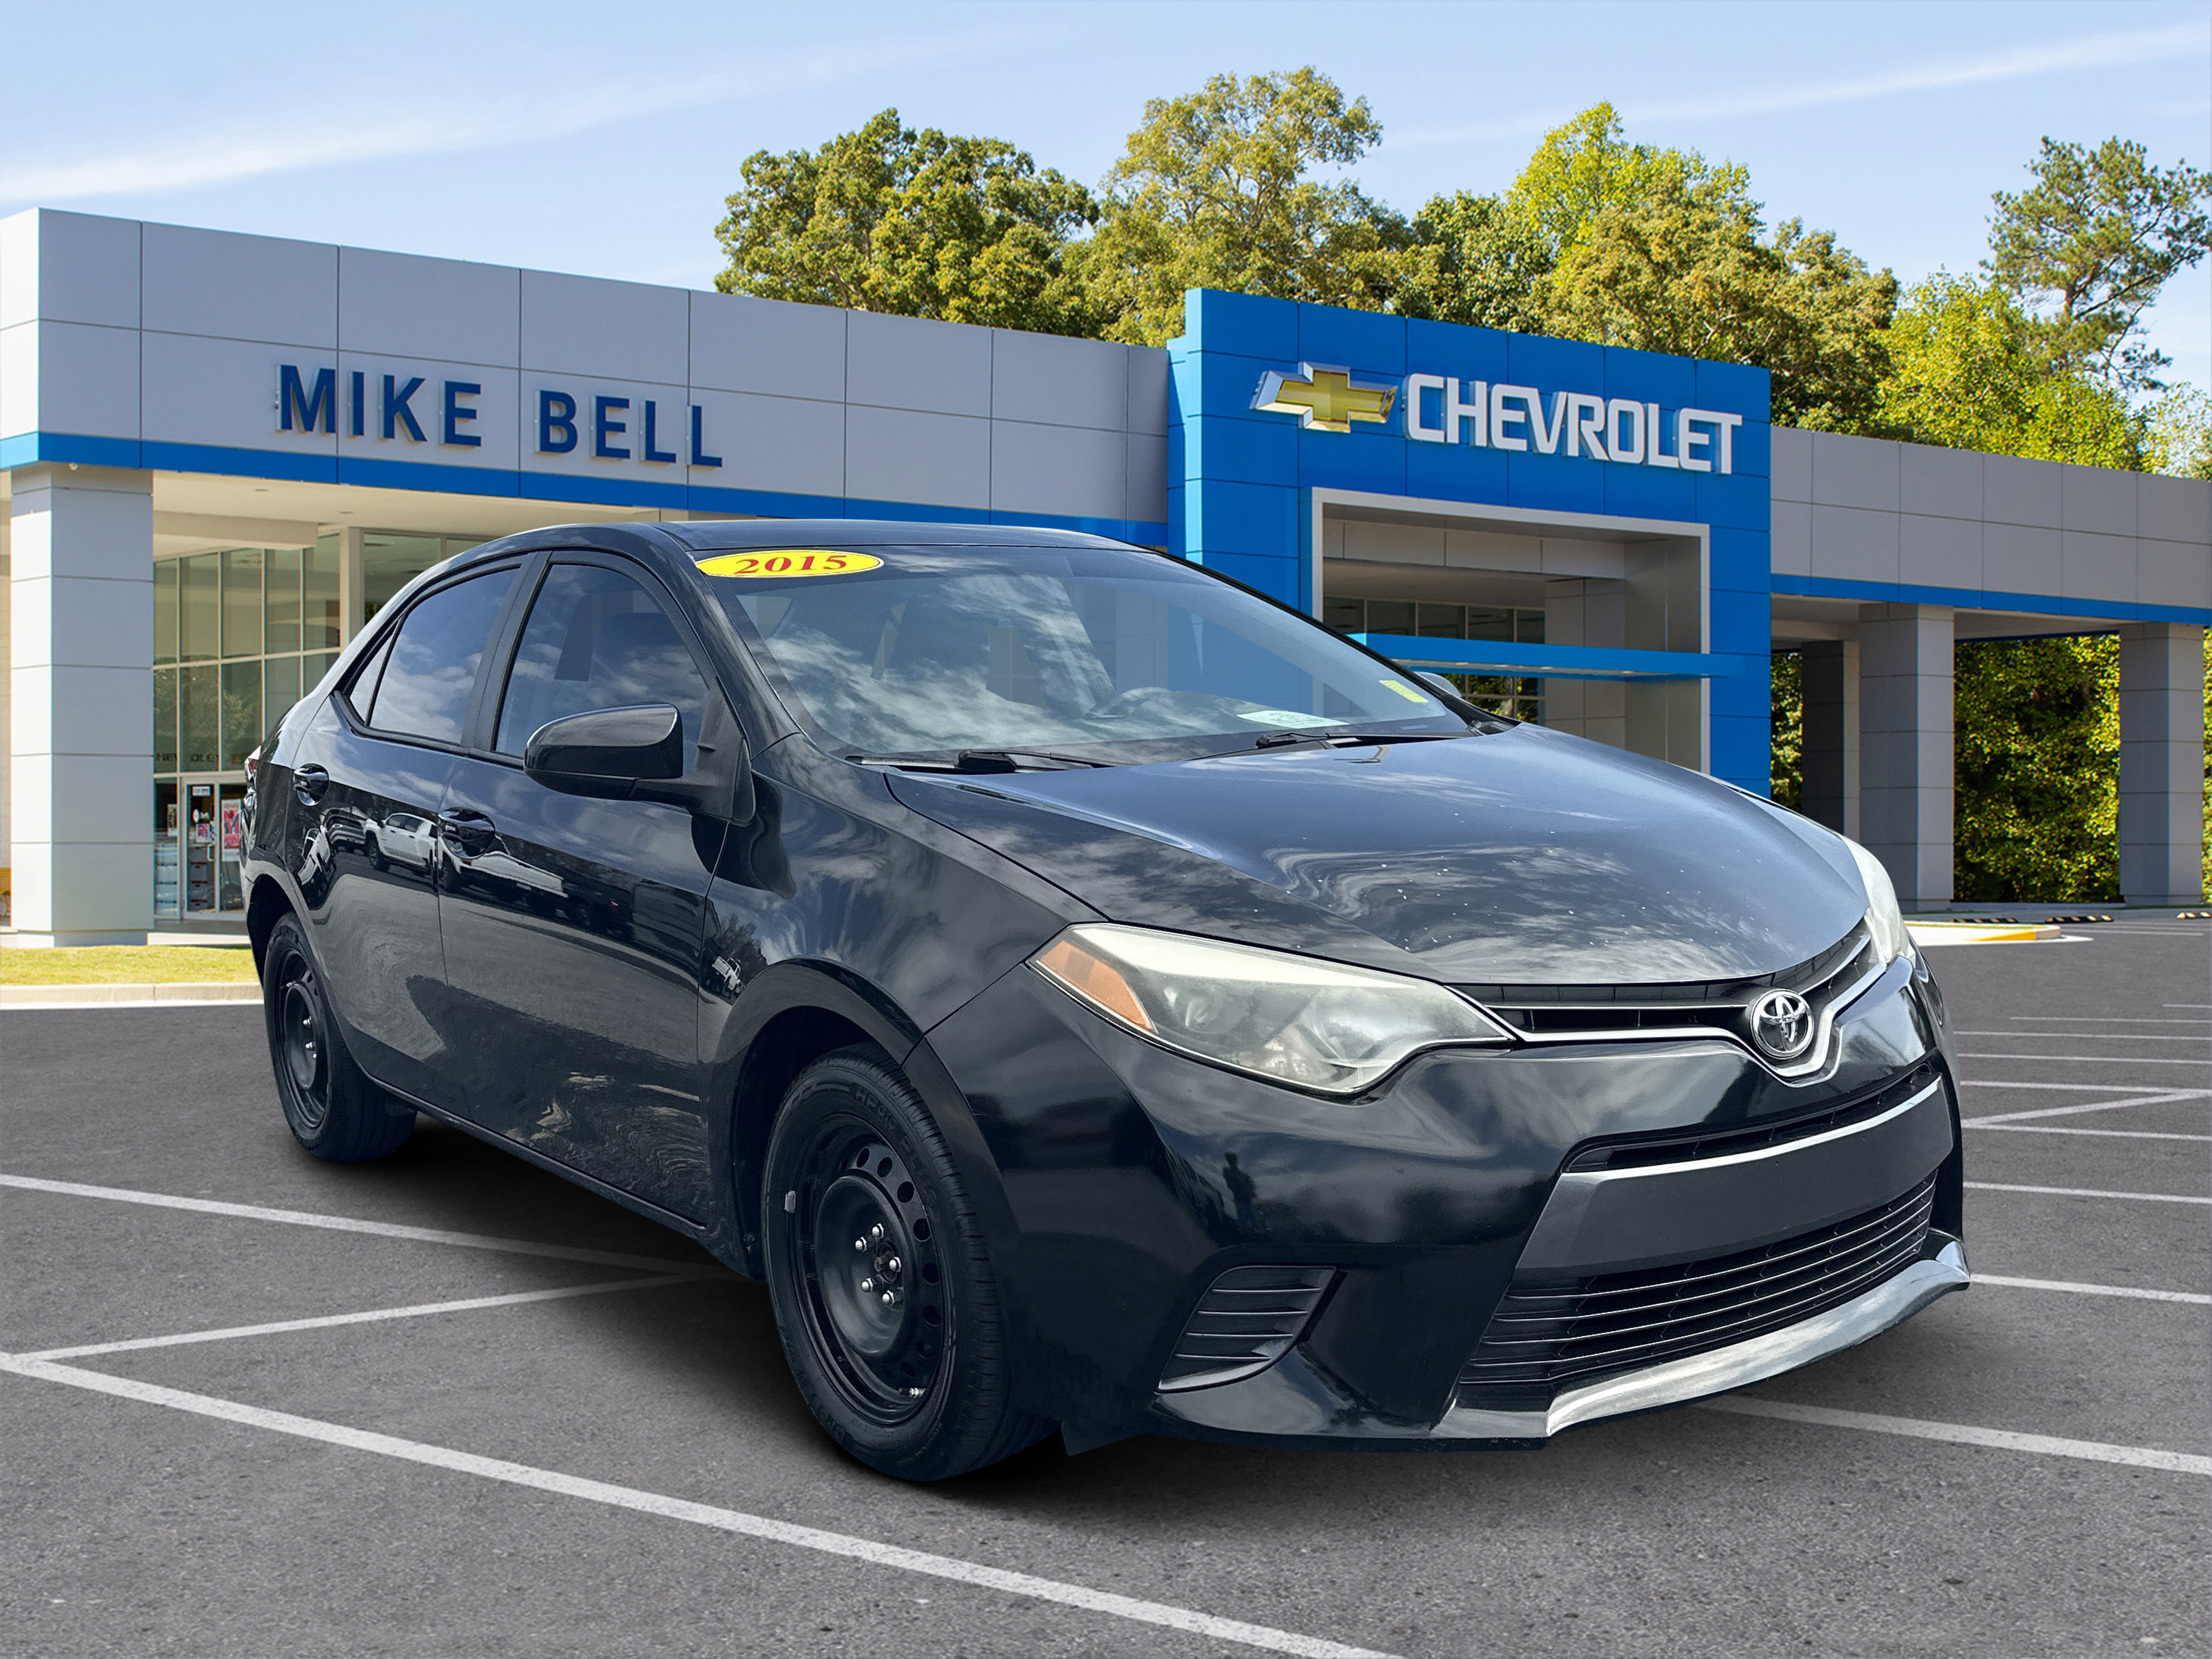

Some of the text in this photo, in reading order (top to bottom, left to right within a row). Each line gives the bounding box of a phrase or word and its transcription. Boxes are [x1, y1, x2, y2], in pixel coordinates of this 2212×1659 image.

[277, 365, 723, 467] MIKE BELL
[1403, 373, 1742, 474] CHEVROLET
[734, 556, 847, 574] 2015
